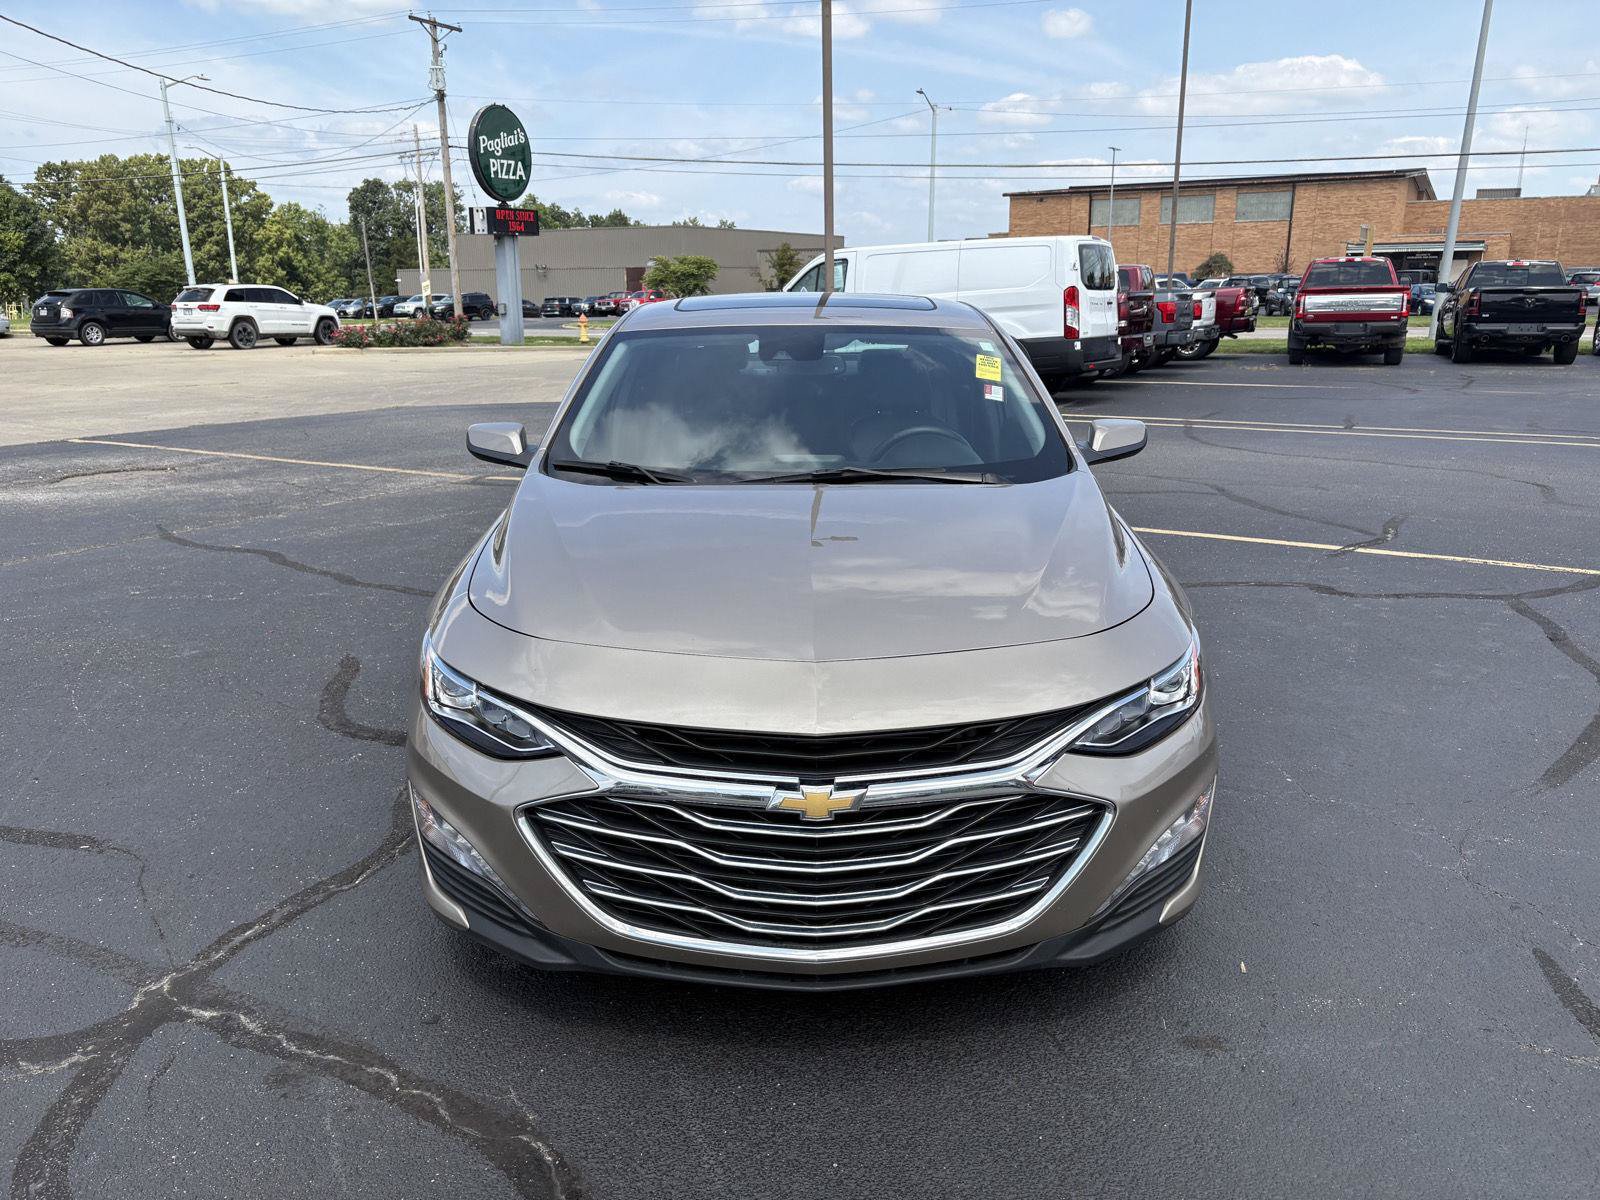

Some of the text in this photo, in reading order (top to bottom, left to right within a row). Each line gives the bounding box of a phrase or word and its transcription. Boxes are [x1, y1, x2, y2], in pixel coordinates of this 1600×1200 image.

[479, 128, 526, 156] Pagliai's
[490, 159, 526, 180] PIZZA
[495, 209, 515, 221] OPEN
[508, 221, 525, 232] 1964
